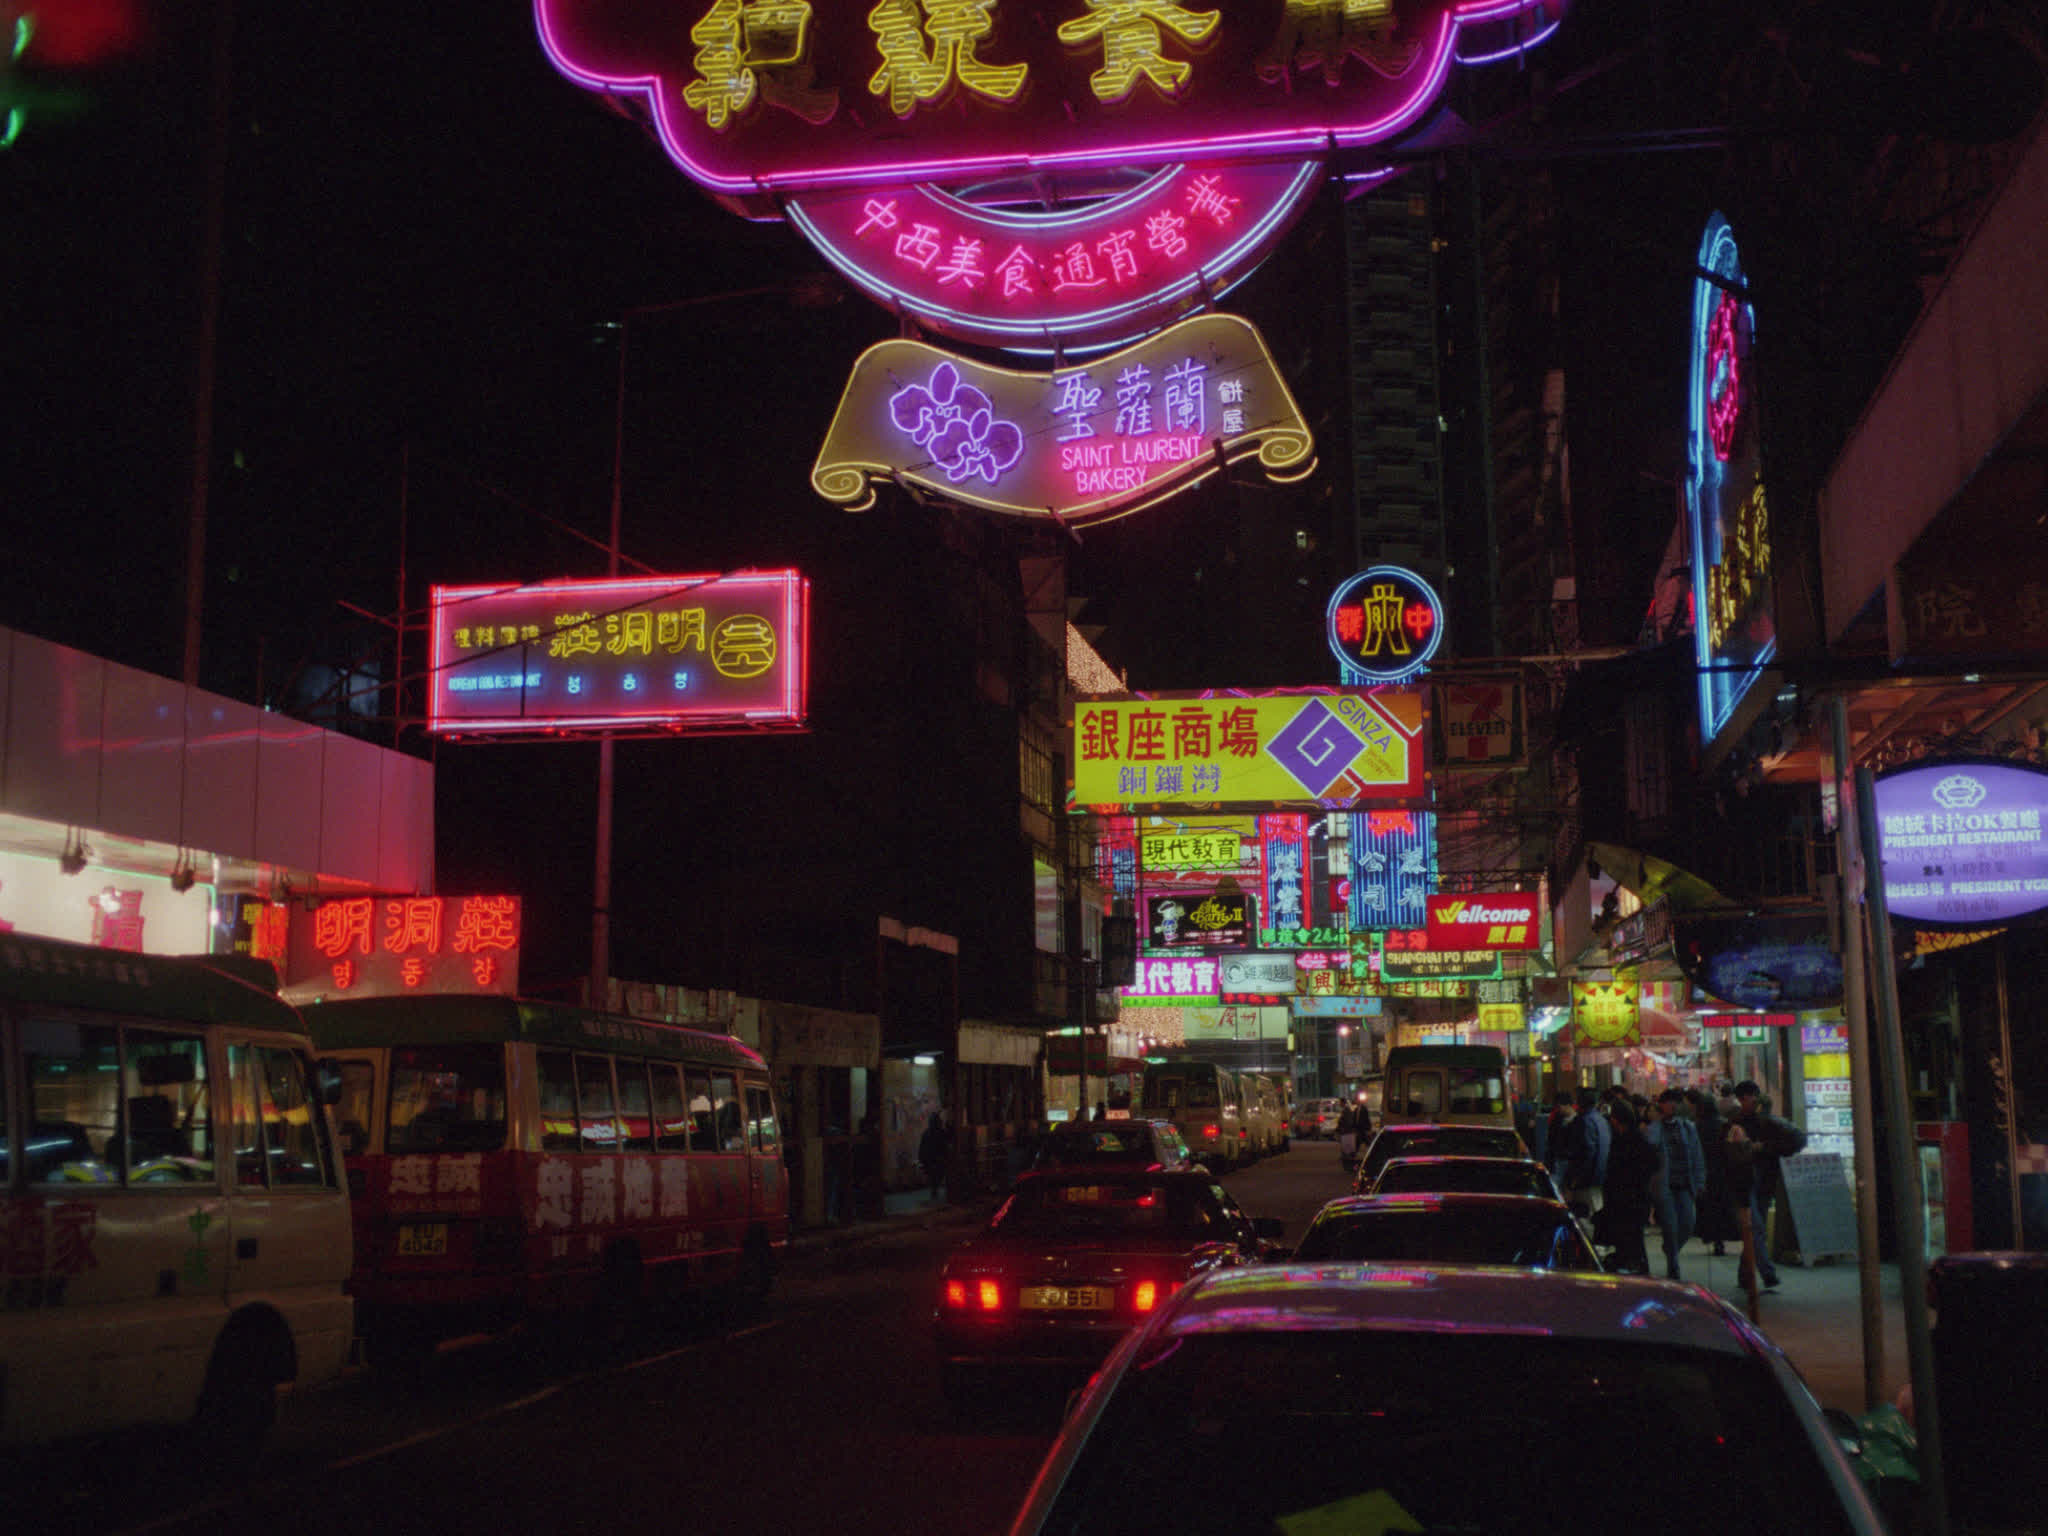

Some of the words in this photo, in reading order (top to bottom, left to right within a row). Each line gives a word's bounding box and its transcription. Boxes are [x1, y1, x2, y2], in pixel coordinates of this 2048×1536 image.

[1061, 444, 1115, 471] SAINT
[1121, 434, 1203, 466] LAURENT
[1075, 464, 1148, 495] BAKERY
[1337, 697, 1393, 754] GINZA
[1117, 763, 1222, 796] 銅鑼灣
[1884, 834, 1953, 849] PRESIDENT
[1957, 828, 2042, 846] RESTAURANT
[1435, 901, 1531, 924] Wellcome
[1386, 952, 1441, 965] SHANGHAI
[1444, 952, 1460, 963] PO
[1463, 950, 1494, 963] KONG
